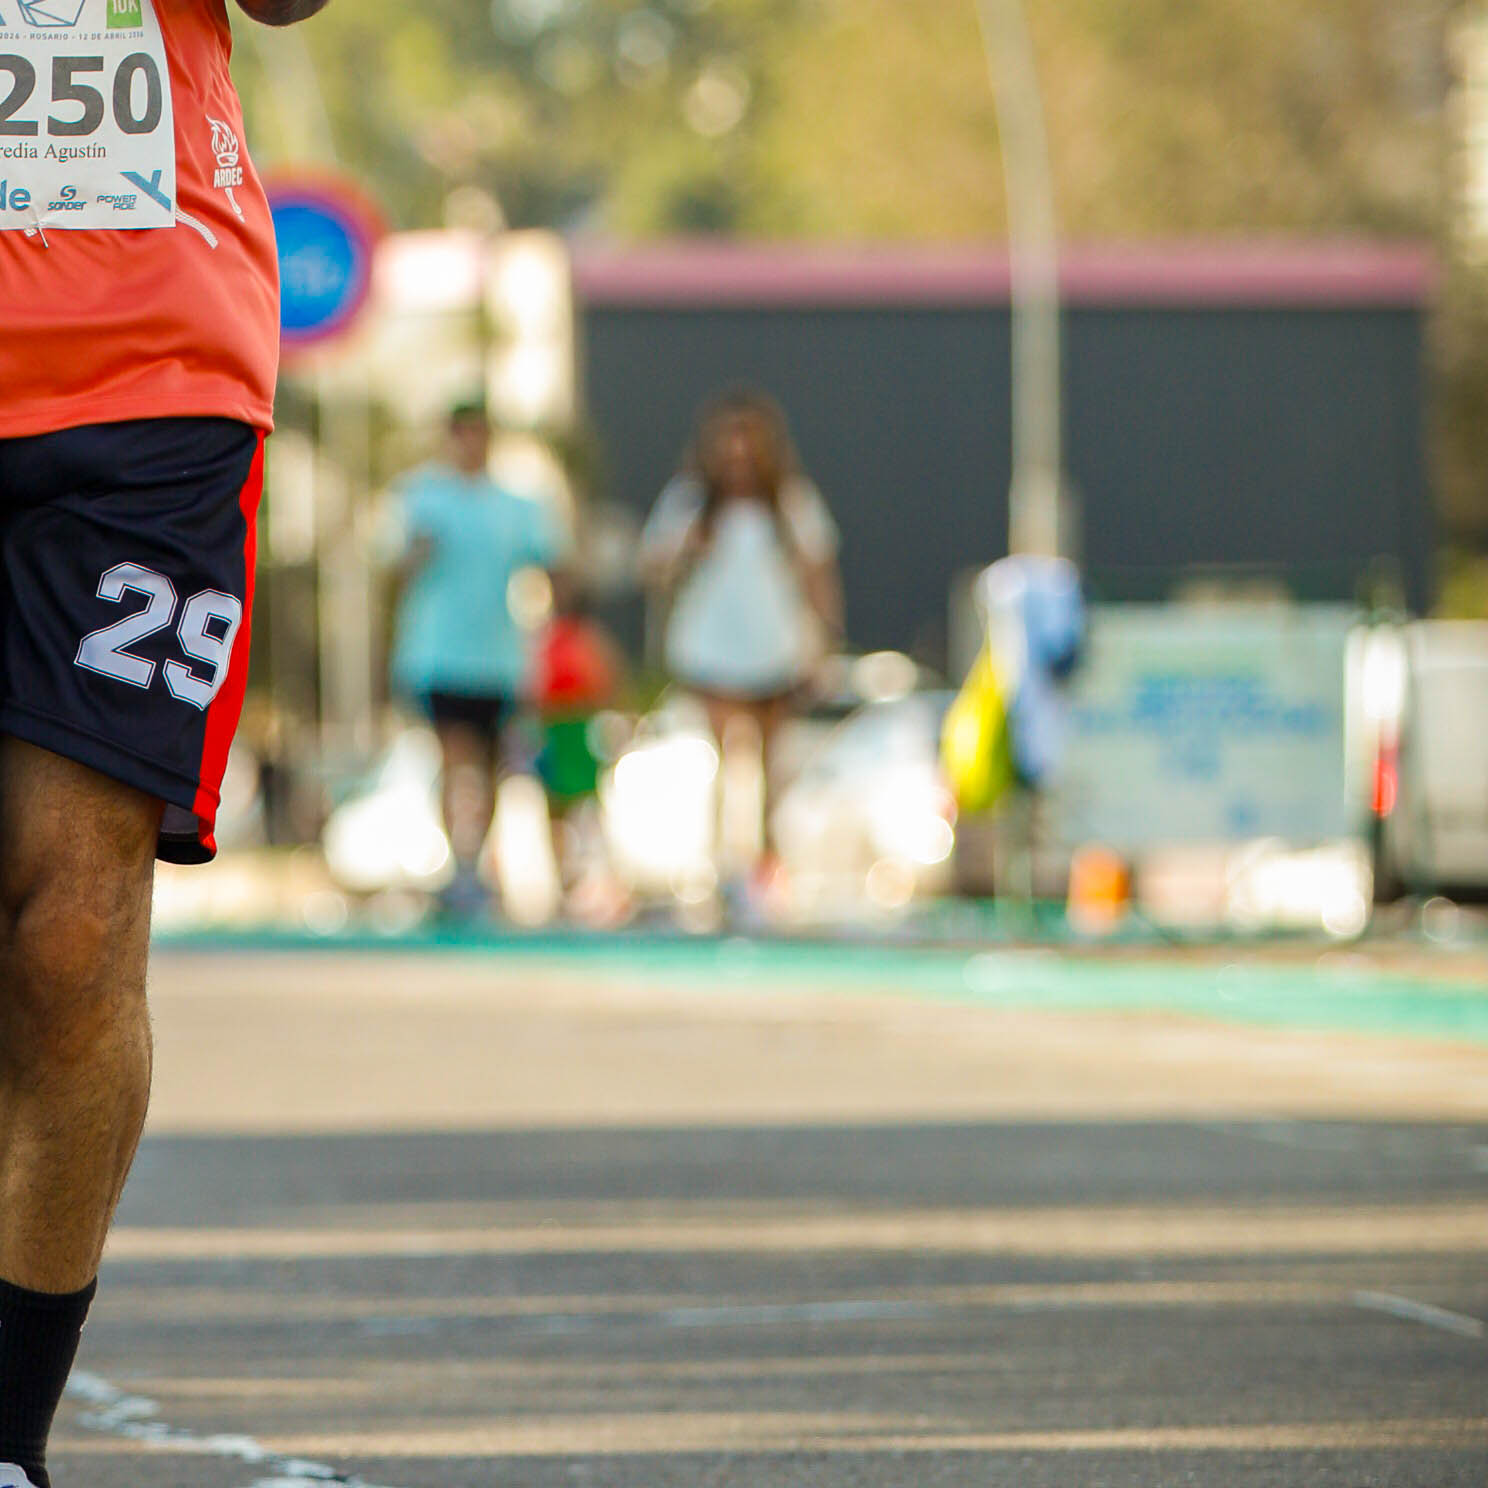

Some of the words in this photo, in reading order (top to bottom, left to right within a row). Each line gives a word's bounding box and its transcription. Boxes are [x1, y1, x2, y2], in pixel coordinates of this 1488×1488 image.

[29, 32, 69, 41] ROSARIO
[78, 32, 88, 41] 12
[91, 32, 102, 41] DE
[43, 141, 107, 163] Agustín
[213, 167, 243, 188] ARDEC
[73, 561, 243, 711] 29
